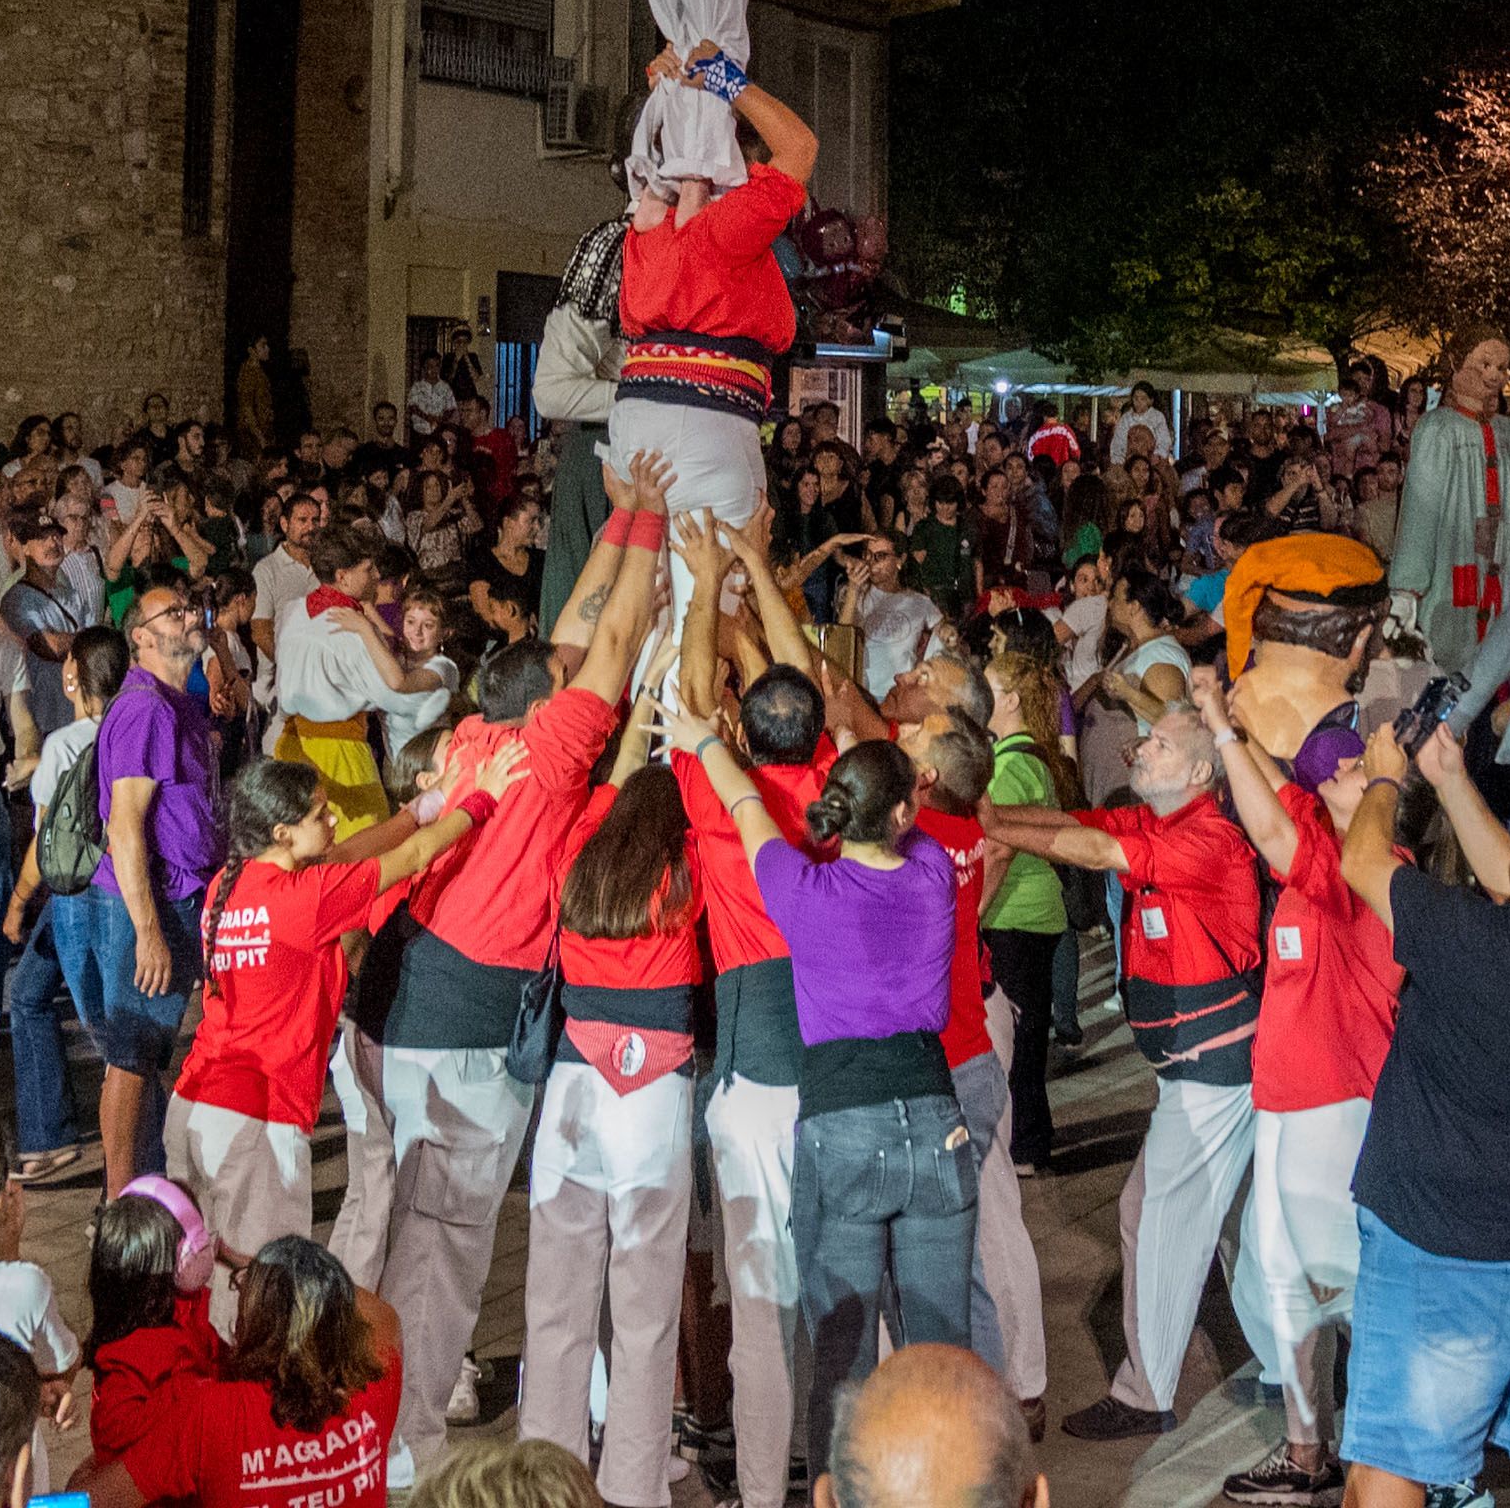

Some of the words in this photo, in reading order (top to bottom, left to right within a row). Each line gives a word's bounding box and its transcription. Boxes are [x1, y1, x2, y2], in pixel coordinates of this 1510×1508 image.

[211, 952, 232, 972] EU
[235, 946, 268, 969] PIT
[241, 1409, 377, 1476] M'AGRADA
[352, 1457, 381, 1498] PIT
